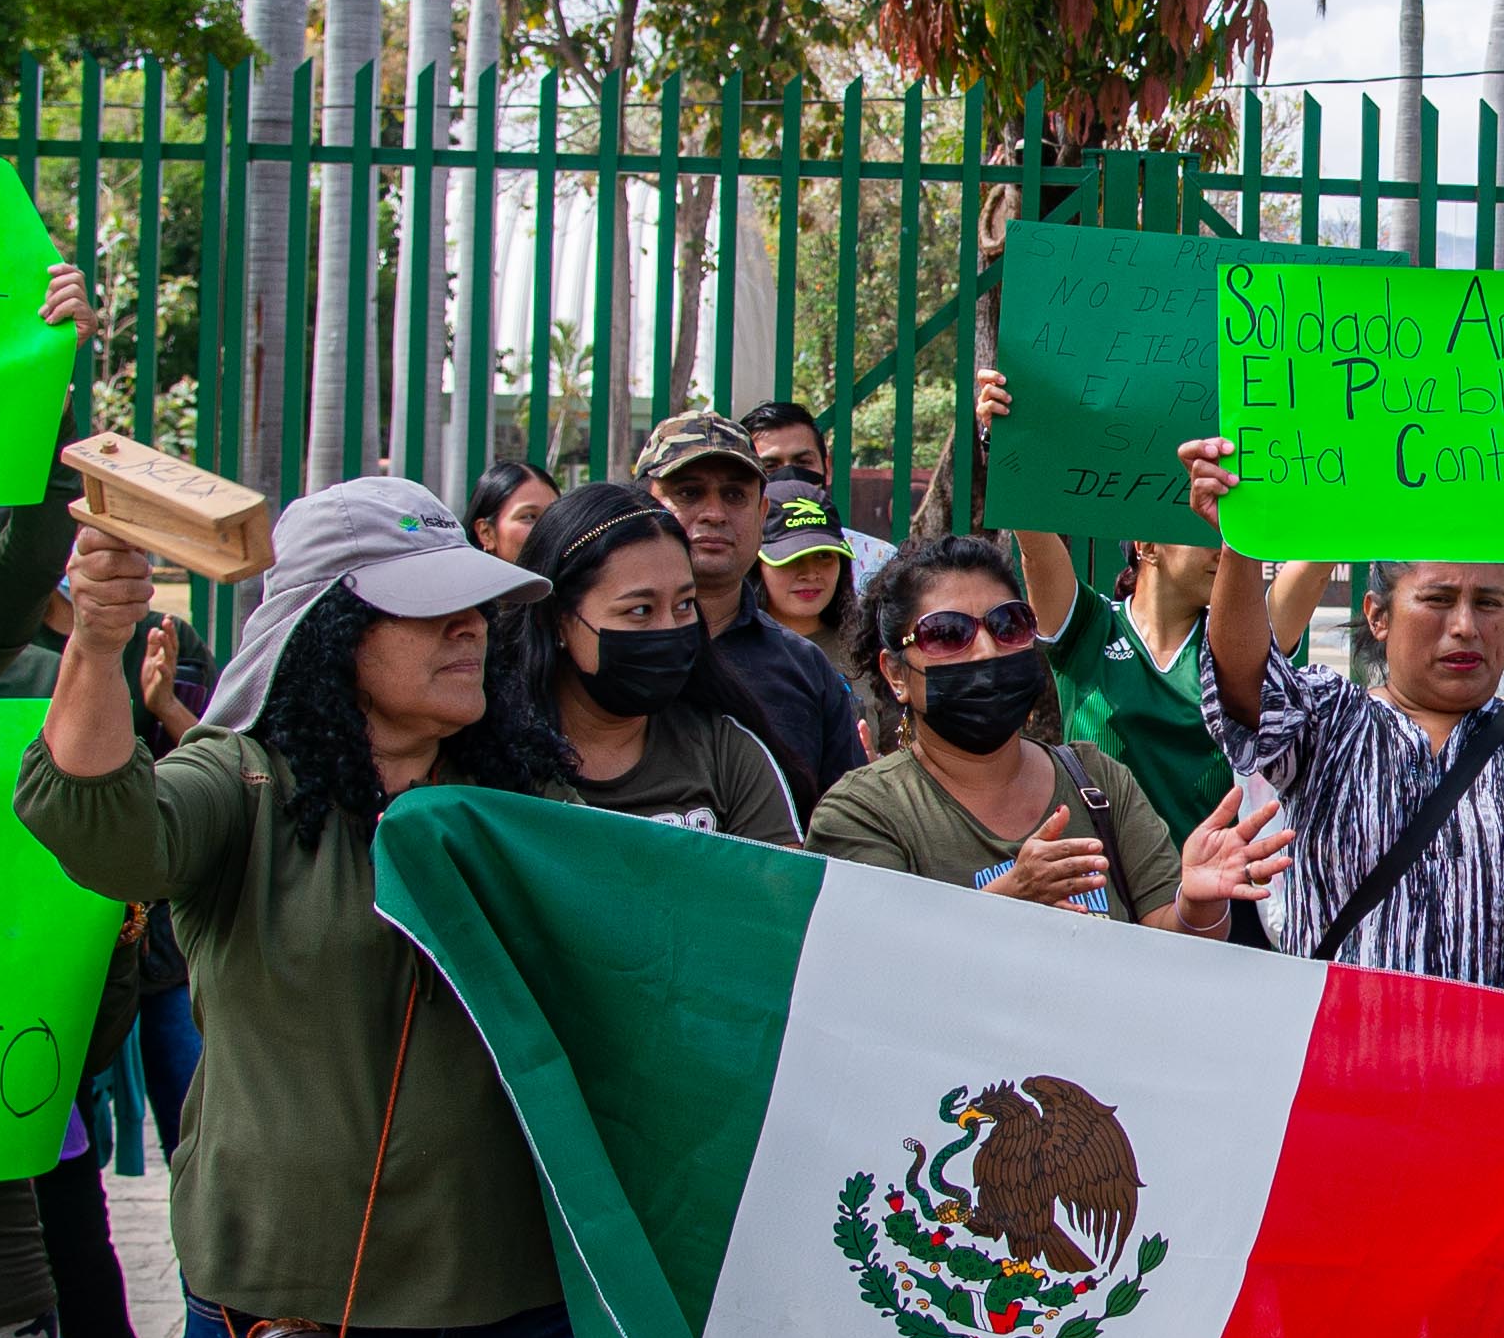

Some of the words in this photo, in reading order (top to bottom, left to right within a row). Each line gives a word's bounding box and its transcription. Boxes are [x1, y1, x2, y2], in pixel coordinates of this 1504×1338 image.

[1108, 235, 1141, 268] EL
[1047, 275, 1110, 310] NO
[1225, 263, 1423, 360] Soldado
[1031, 322, 1077, 358] AL
[1079, 374, 1130, 409] EL
[1242, 355, 1295, 409] El
[1236, 426, 1347, 486] Esta
